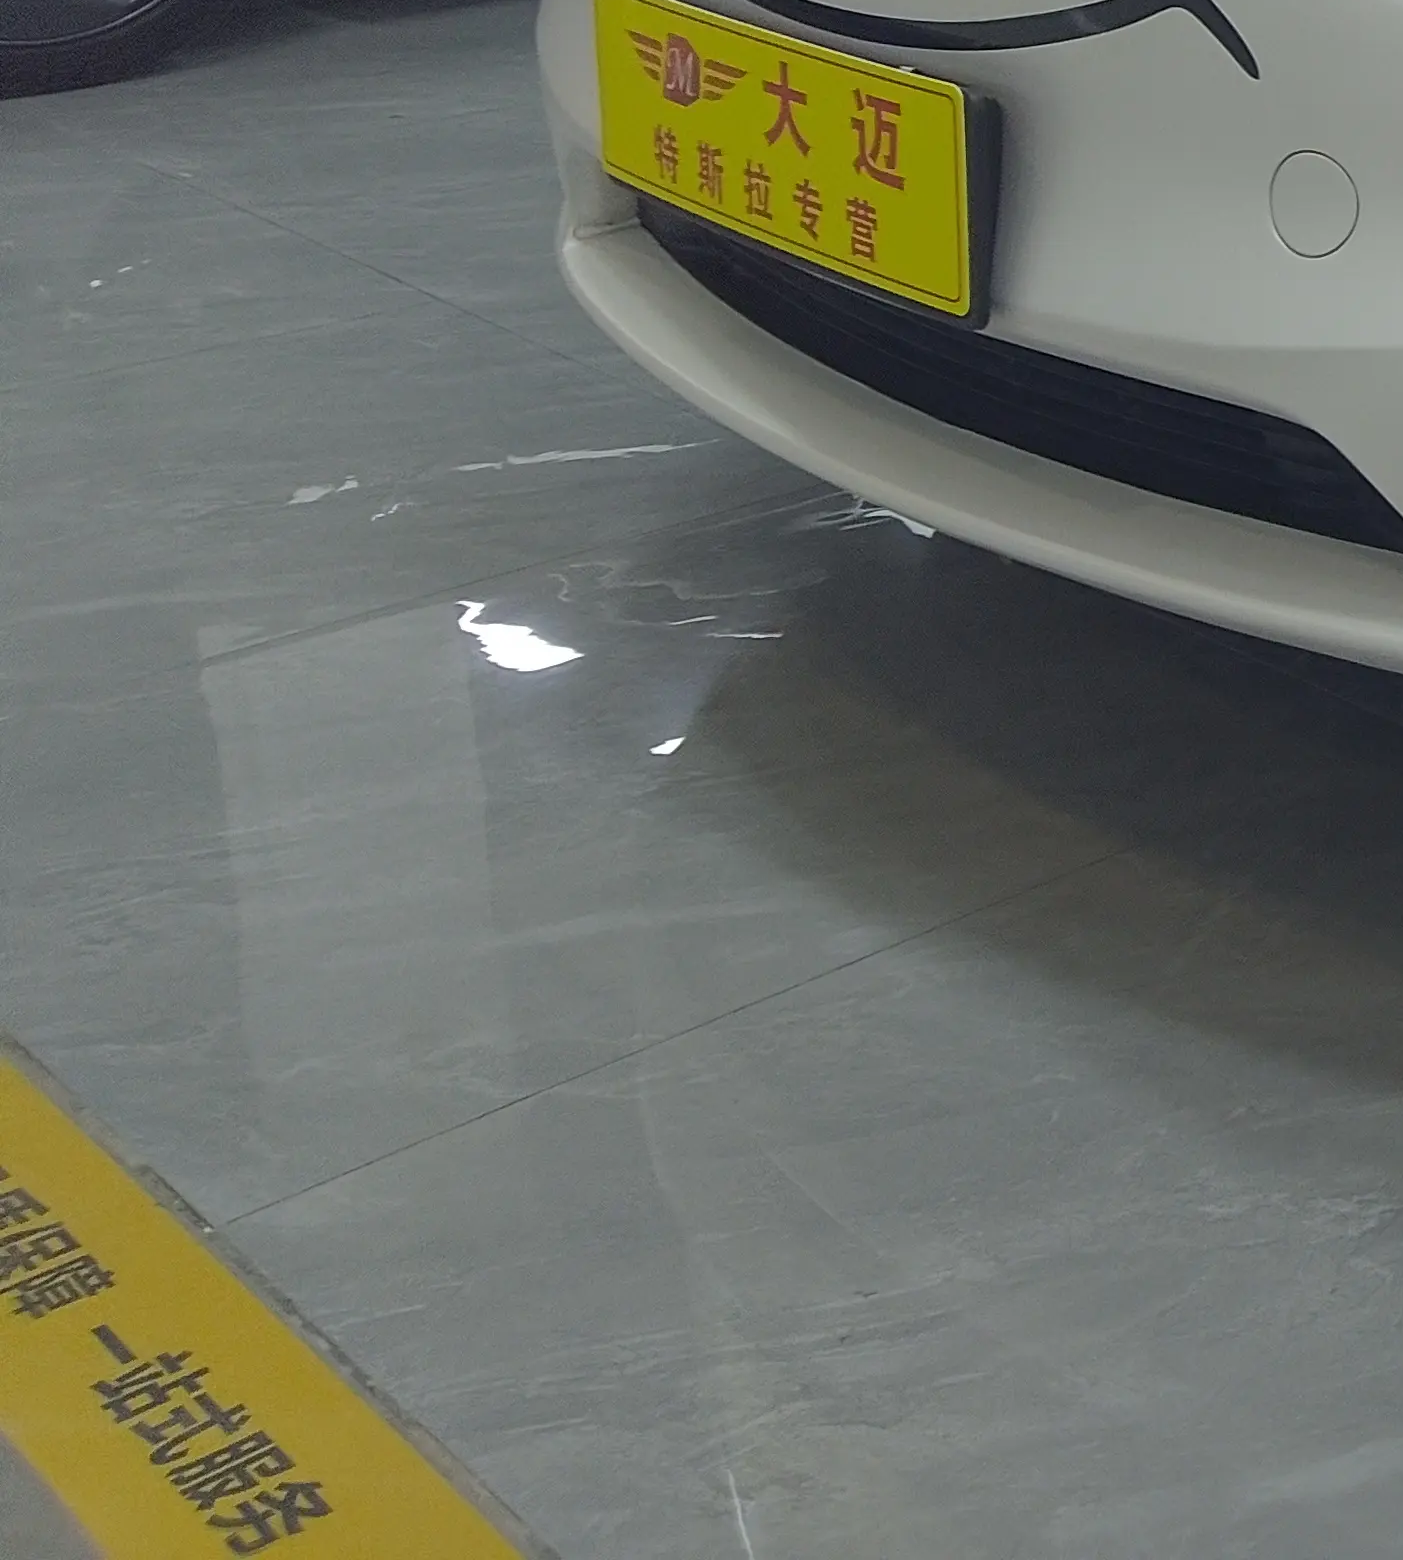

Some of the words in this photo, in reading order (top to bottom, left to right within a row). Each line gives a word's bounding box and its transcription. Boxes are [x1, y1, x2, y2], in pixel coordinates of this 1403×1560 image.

[653, 124, 877, 263] 特斯拉专营
[763, 61, 906, 191] 大迈
[90, 1324, 334, 1556] 一站式服务
